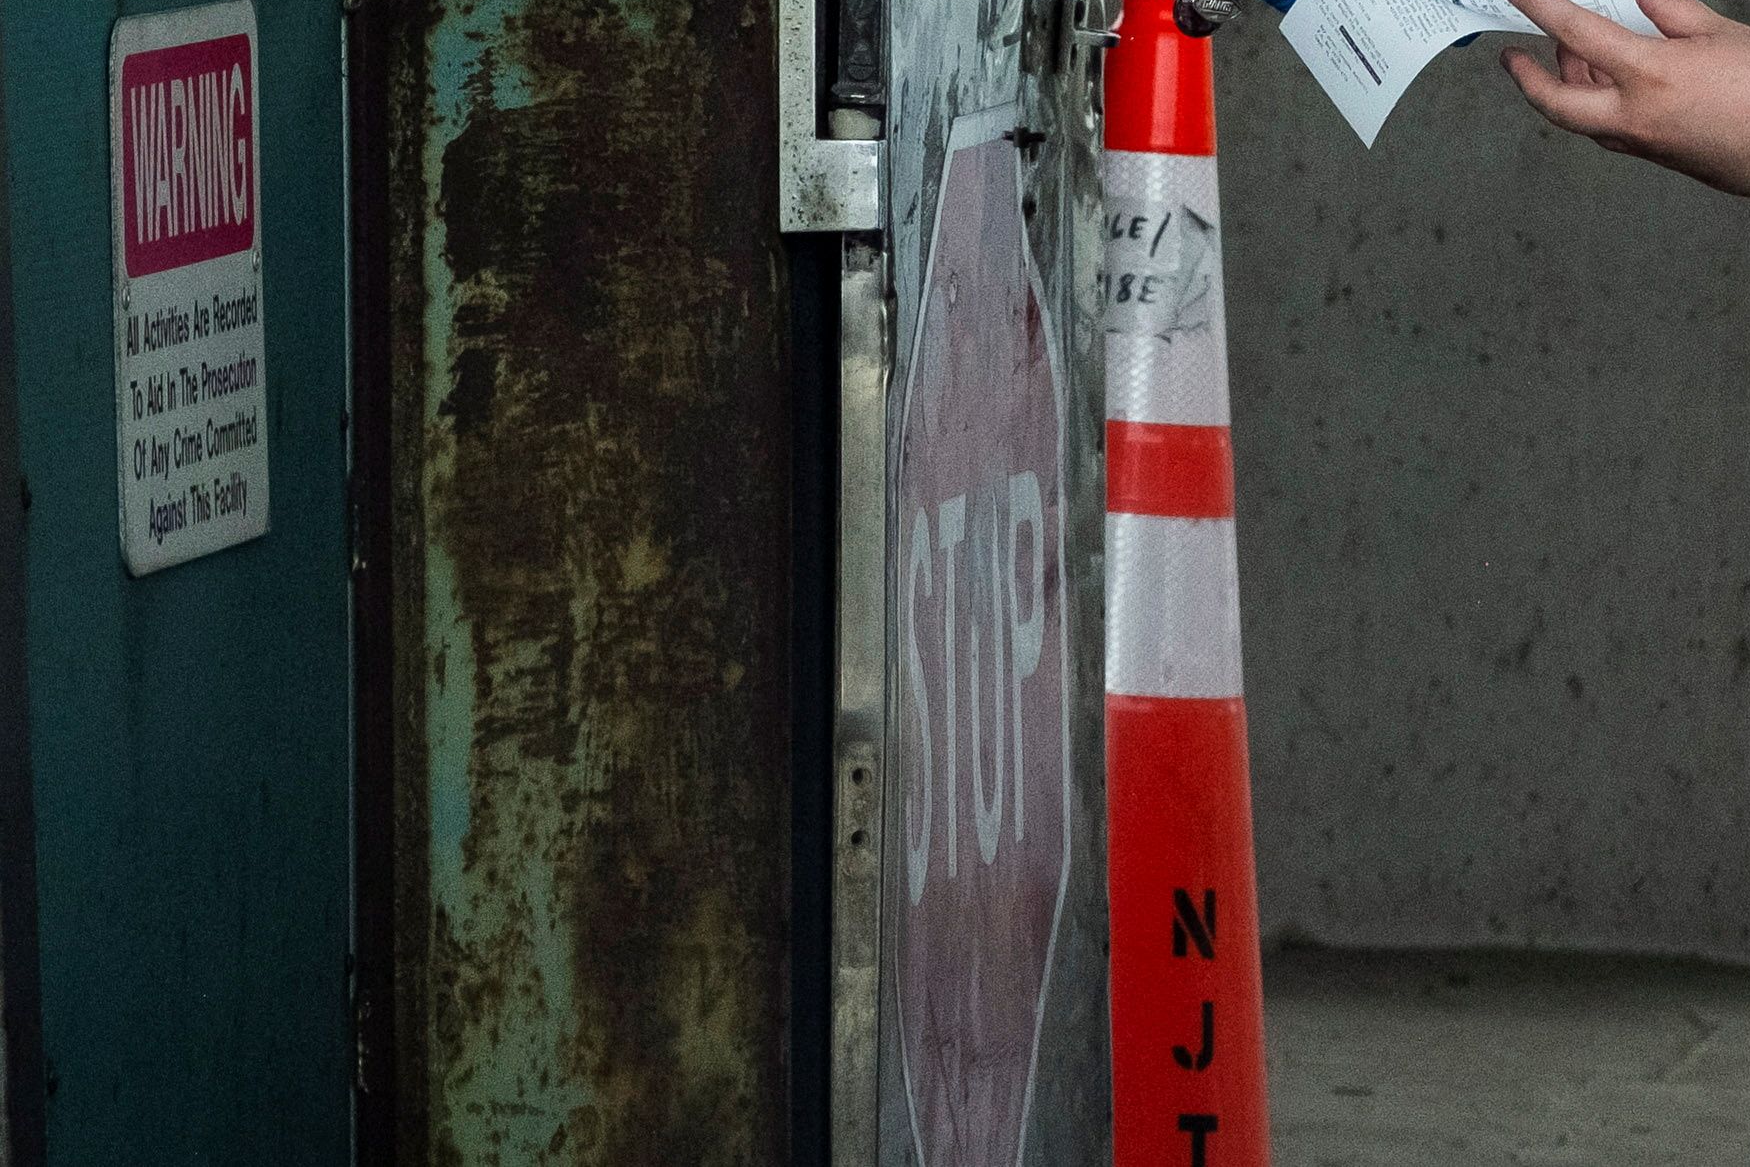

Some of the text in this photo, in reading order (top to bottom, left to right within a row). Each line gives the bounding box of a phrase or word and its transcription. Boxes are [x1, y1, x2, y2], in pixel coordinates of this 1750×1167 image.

[131, 63, 247, 245] WARNING
[127, 284, 257, 357] All Activities Are Recorded
[130, 350, 257, 421] To Aid In The Prosecution
[134, 405, 257, 481] Of Any Crime Committed
[149, 471, 247, 545] Against This Facility
[906, 471, 1045, 906] STOP
